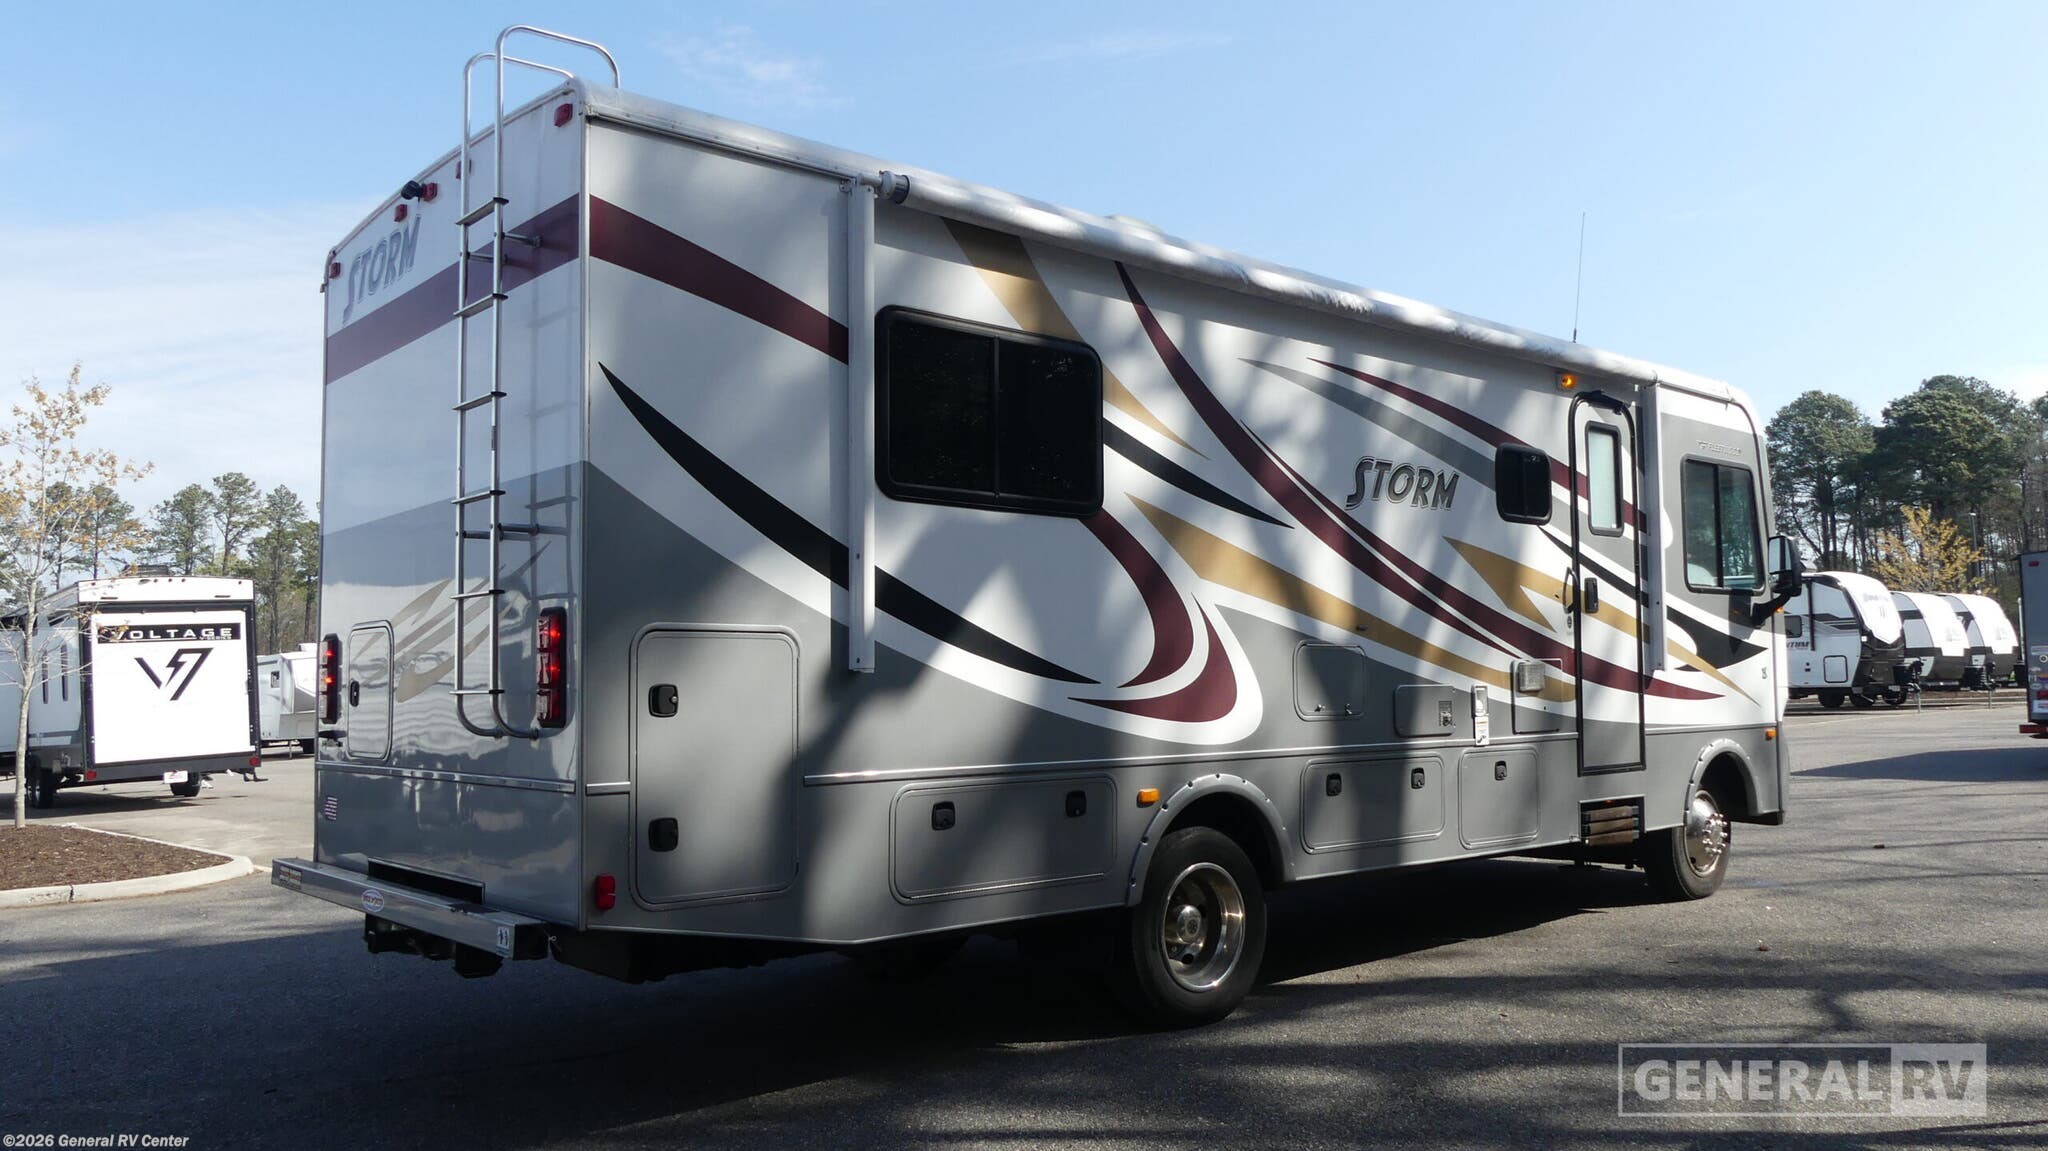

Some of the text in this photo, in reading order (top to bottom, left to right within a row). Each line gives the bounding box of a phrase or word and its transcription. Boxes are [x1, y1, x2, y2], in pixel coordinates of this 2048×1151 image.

[342, 213, 421, 326] STORM
[1344, 455, 1460, 511] STORM
[112, 627, 232, 640] VOLTAGE
